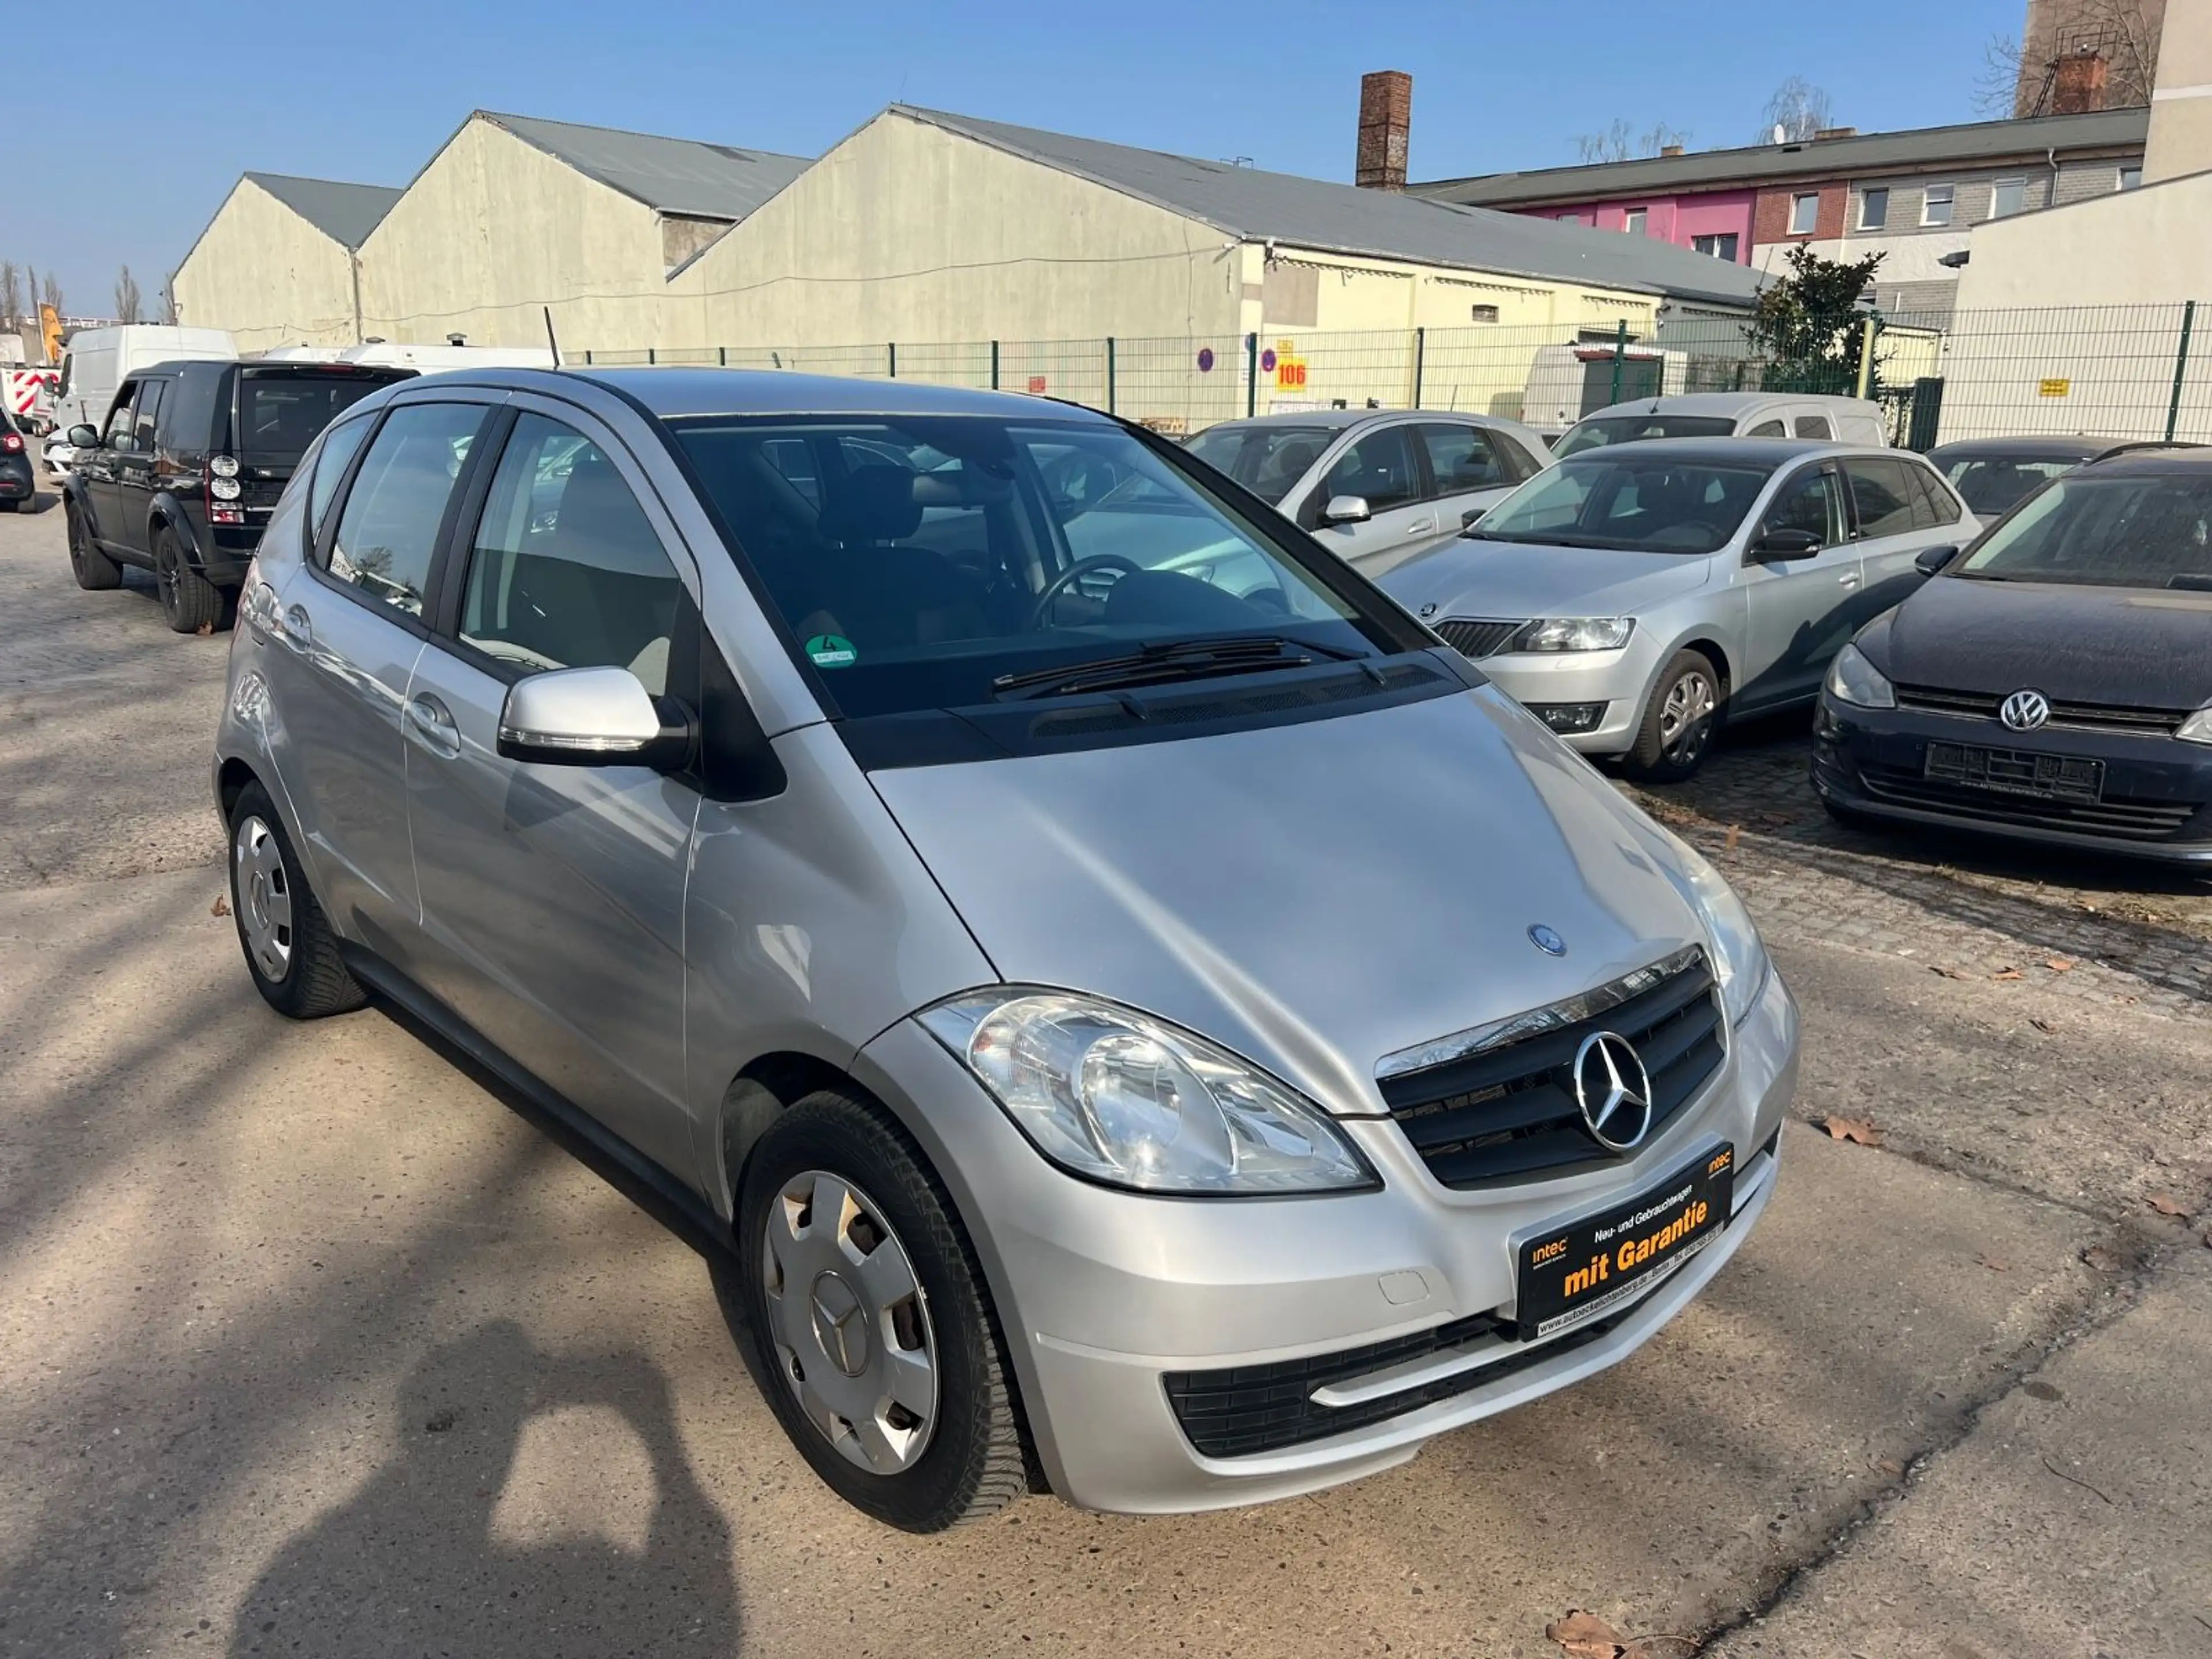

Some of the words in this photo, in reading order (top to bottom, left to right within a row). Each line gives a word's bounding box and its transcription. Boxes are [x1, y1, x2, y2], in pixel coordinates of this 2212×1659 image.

[1279, 365, 1306, 385] 106
[2001, 691, 2048, 730] VW
[1708, 1151, 1731, 1174] intec
[1594, 1227, 1616, 1244] Neu-
[1618, 1215, 1634, 1233] und
[1635, 1184, 1692, 1225] Gebrauchtwagen
[1533, 1239, 1567, 1263] intec
[1565, 1252, 1609, 1297] mit
[1617, 1200, 1707, 1271] Garantie
